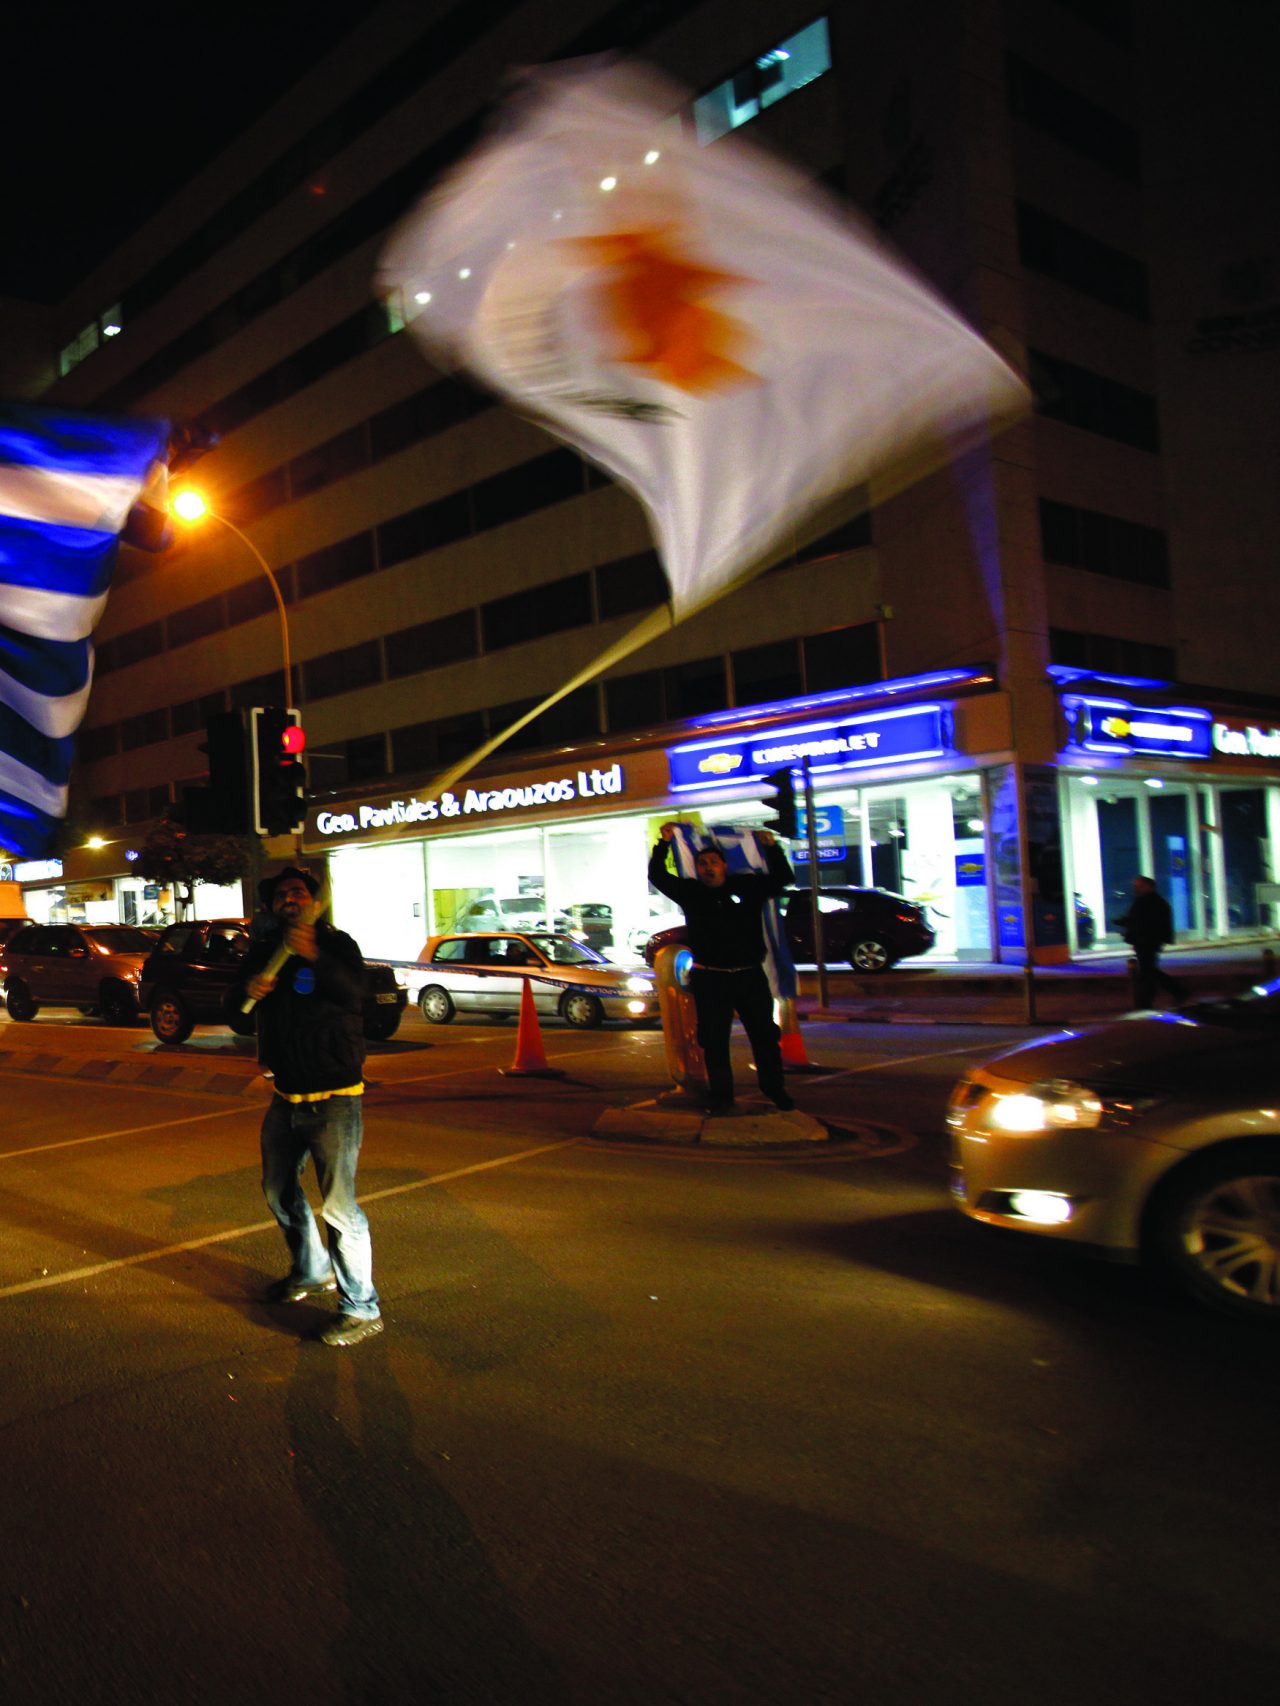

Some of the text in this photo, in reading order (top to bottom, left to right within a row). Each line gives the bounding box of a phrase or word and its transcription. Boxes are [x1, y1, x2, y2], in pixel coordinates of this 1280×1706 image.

[317, 763, 622, 834] Geo. Pavlides & Araouzos Ltd
[801, 811, 832, 834] 5
